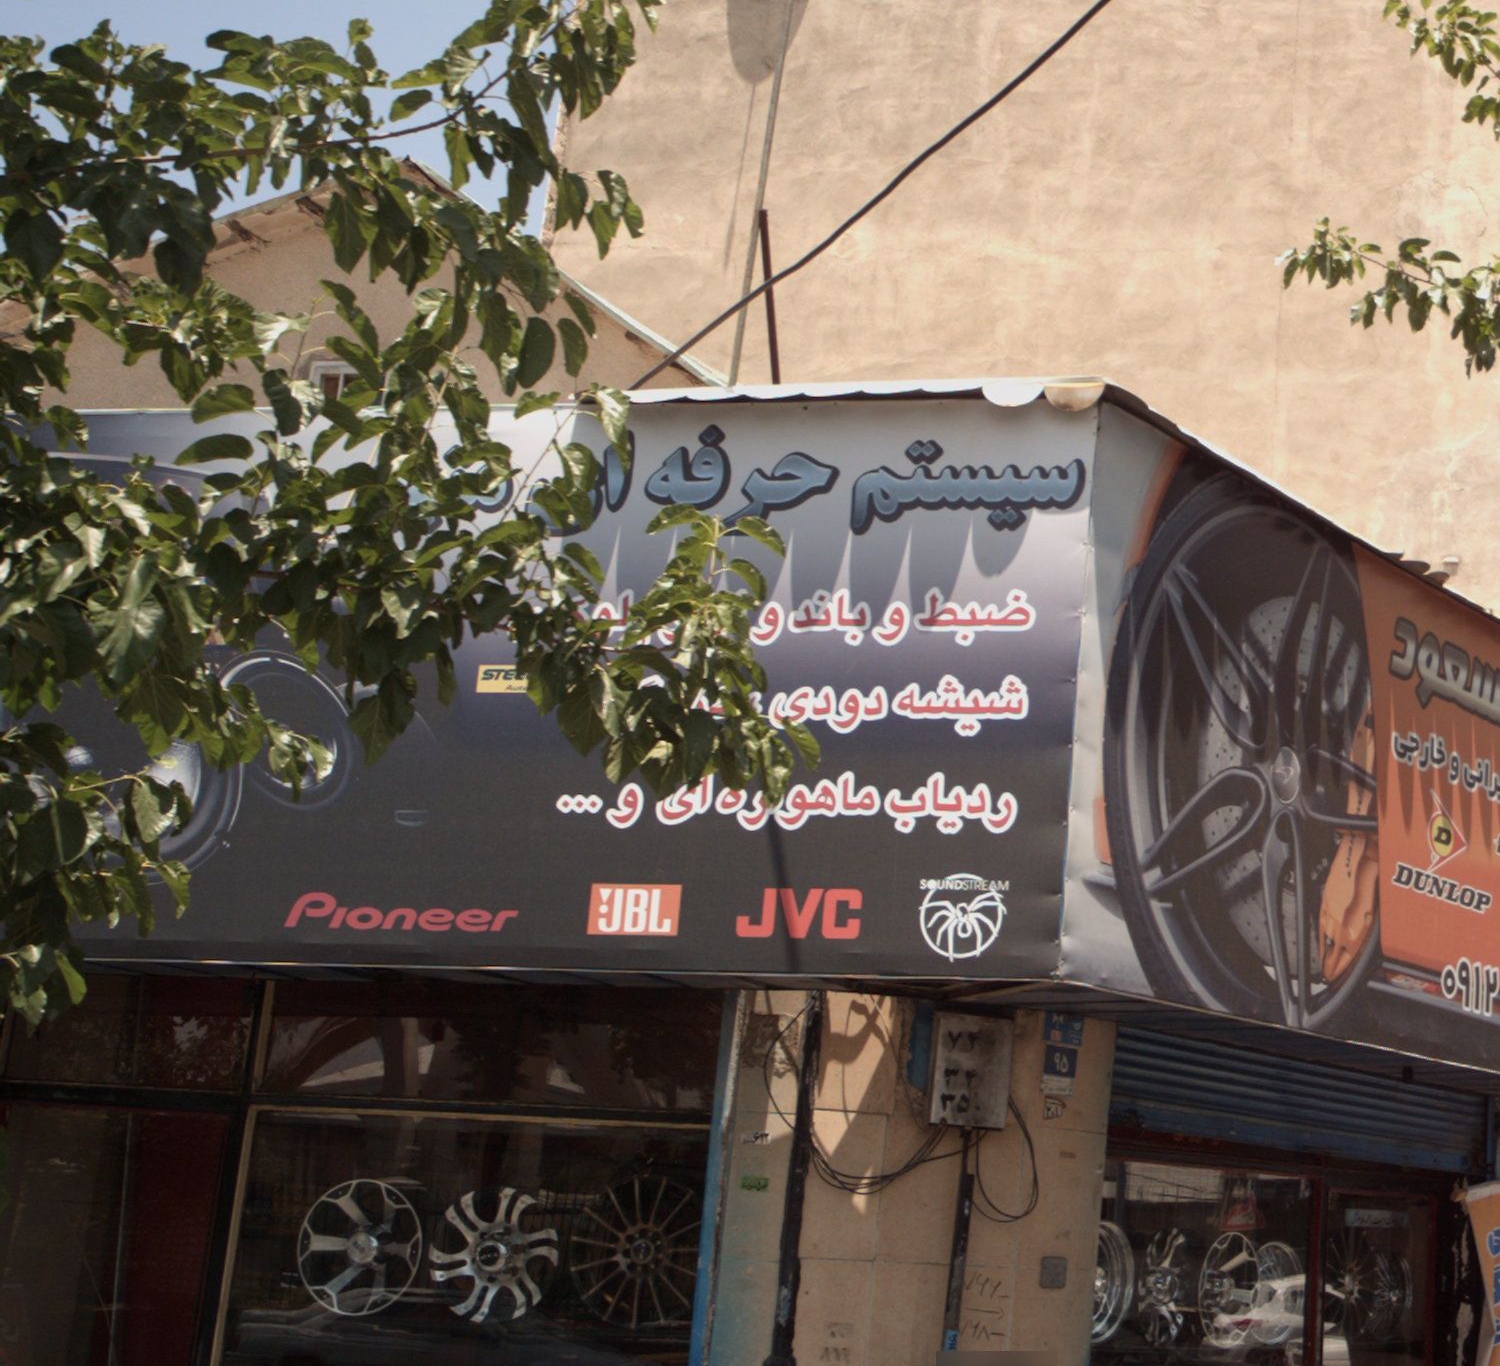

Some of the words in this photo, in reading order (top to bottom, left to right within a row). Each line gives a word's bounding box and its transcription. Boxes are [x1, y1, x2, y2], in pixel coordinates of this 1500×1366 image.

[645, 424, 838, 537] حرفه
[851, 438, 1085, 534] سیستم
[749, 601, 784, 645] و
[788, 590, 871, 645] باند
[871, 601, 910, 645] و
[915, 587, 1036, 645] ضبط
[768, 685, 887, 732] دودی
[891, 674, 1028, 736] شیشه
[1392, 732, 1446, 773] خارجی
[1448, 751, 1459, 785] و
[606, 783, 643, 829] و
[713, 771, 880, 831] ماهوره
[884, 772, 1018, 833] ردیاب
[919, 878, 1010, 892] SOUNDSTREAM
[1392, 862, 1493, 915] DUNLOP
[283, 892, 519, 932] Pioneer
[598, 888, 673, 934] JBL
[735, 888, 863, 939] JVC
[1441, 957, 1499, 1017] ۰۹۱۲
